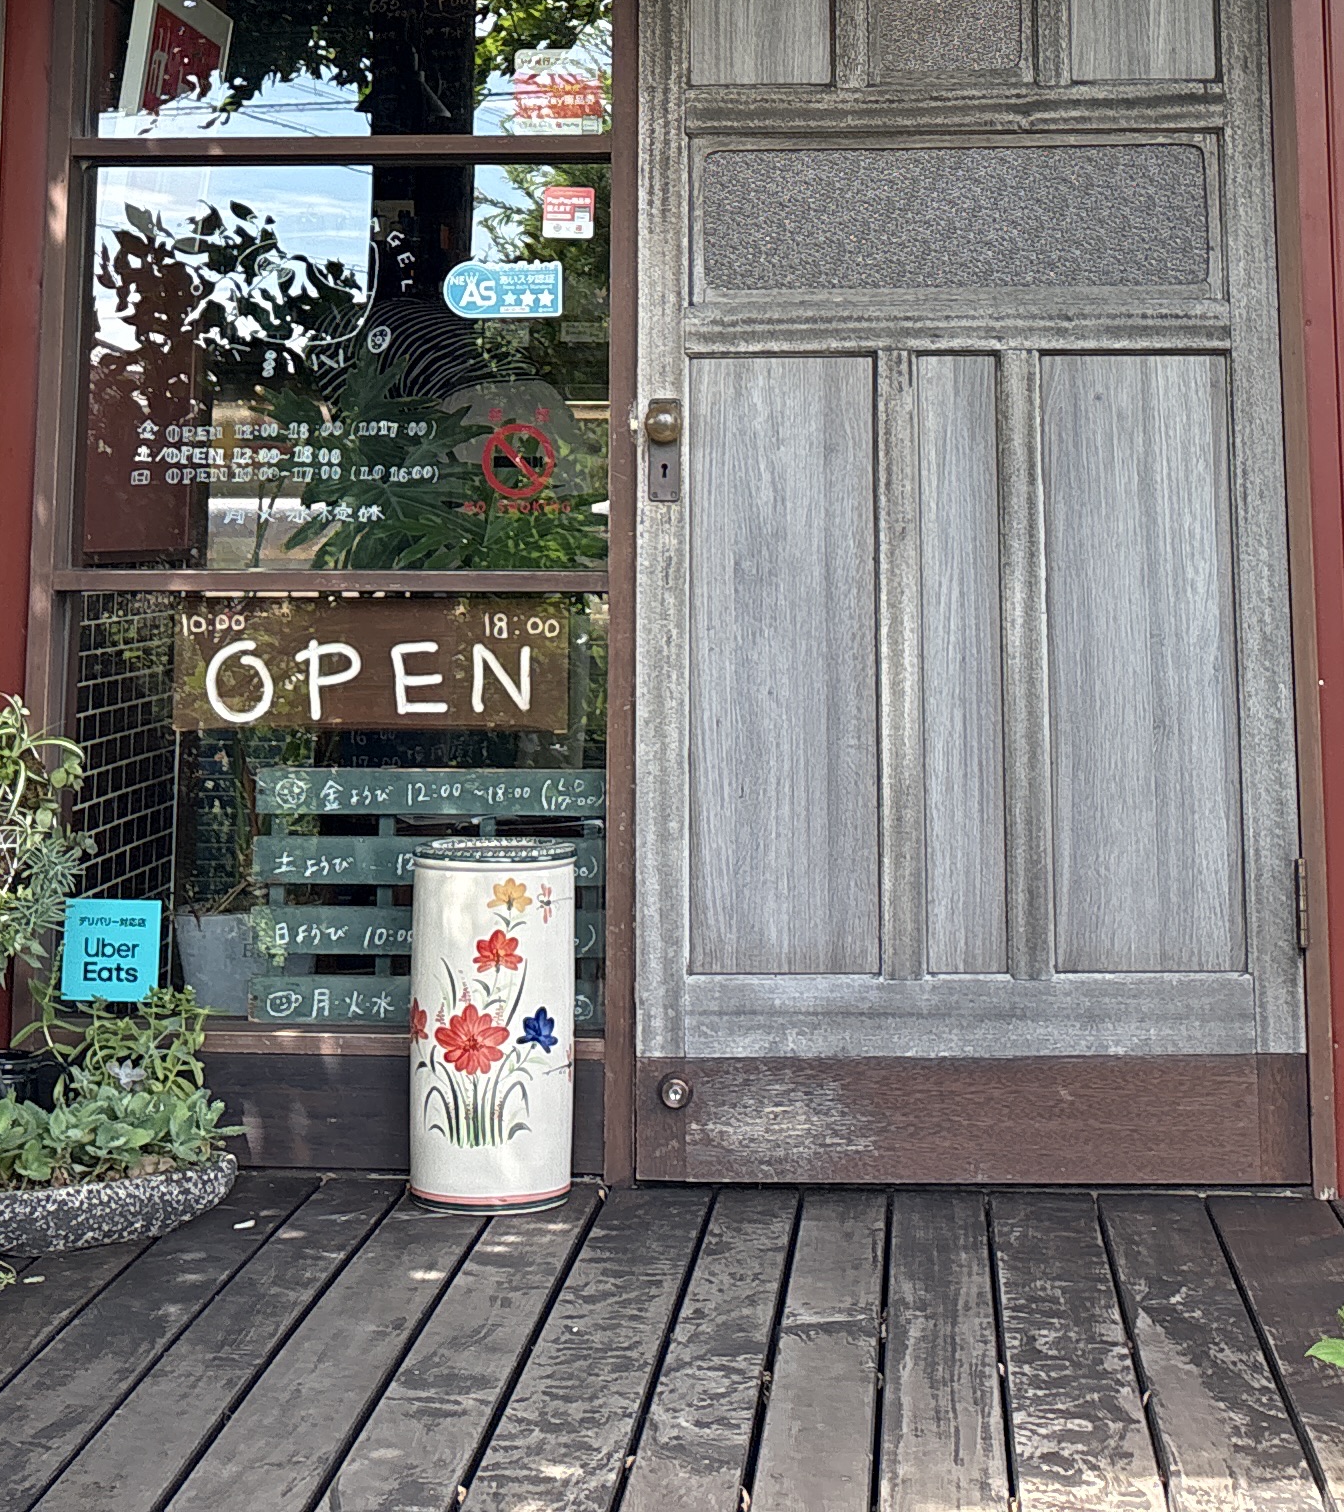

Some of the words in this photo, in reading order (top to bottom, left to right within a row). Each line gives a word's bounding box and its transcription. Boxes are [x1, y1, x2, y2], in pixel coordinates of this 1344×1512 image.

[450, 272, 478, 286] NEW
[499, 274, 556, 284] あいスタ認証
[459, 280, 497, 307] AS
[165, 425, 223, 443] OPEN
[130, 469, 151, 486] 日
[165, 467, 228, 485] OPEN
[463, 500, 487, 514] NO
[181, 614, 245, 636] 10:00
[485, 613, 560, 639] 18:00
[205, 639, 532, 723] OPEN
[320, 779, 393, 811] 金ようび
[407, 782, 461, 806] 12:00
[273, 851, 354, 877] 土ようび
[79, 916, 147, 928] デリバリー対応店
[275, 922, 349, 947] 日ようび
[84, 937, 140, 959] Uber
[83, 961, 139, 983] Eats
